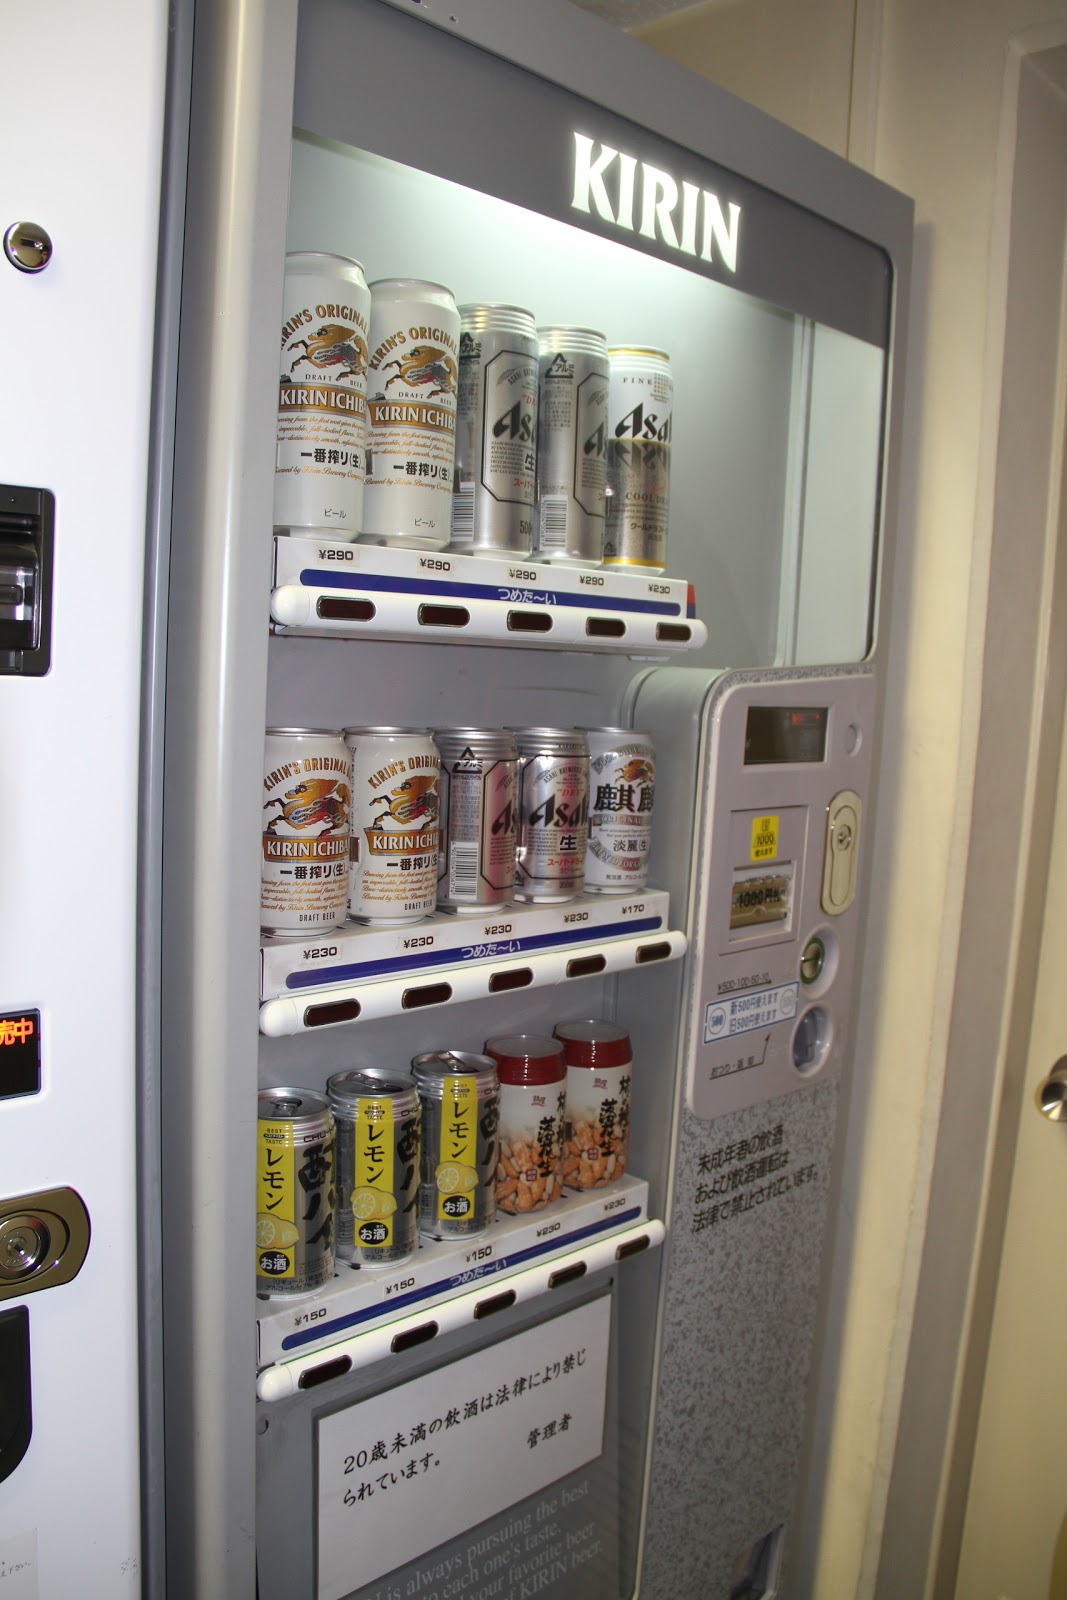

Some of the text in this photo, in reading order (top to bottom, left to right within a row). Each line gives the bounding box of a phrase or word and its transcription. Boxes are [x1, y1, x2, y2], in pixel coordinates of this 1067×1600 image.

[571, 131, 741, 273] KIRIN
[280, 304, 367, 350] IRIN'S ORIGINAL
[368, 326, 457, 370] KIRIN'S ORIGINAL
[462, 343, 481, 353] アルミ
[555, 364, 574, 373] アルミ
[305, 373, 362, 388] DRAFT BEER
[623, 377, 652, 385] FINE
[280, 389, 366, 415] KIRIN ICHIB
[398, 391, 424, 399] DRAFT
[375, 406, 456, 431] KIRIN ICHIB
[615, 402, 673, 443] Asa
[626, 492, 653, 502] COOL
[324, 508, 347, 519] ビール
[414, 518, 435, 528] ビール
[318, 549, 354, 561] ¥290
[420, 557, 451, 572] ¥290
[509, 568, 537, 581] ¥290
[580, 575, 605, 586] ¥290
[648, 583, 671, 594] ¥230
[464, 758, 483, 768] アルミ
[263, 757, 347, 791] KIRIN'S ORIGINAL
[368, 760, 406, 789] KIRIN'S
[543, 771, 558, 784] ASAHI
[267, 840, 311, 857] KIRIN
[373, 835, 414, 850] KIRIN
[560, 834, 577, 851] 生
[405, 902, 421, 910] DRAFT
[622, 904, 645, 914] ¥170
[299, 912, 336, 922] DRAFT BEER
[564, 912, 589, 922] ¥230
[484, 924, 512, 936] ¥230
[403, 936, 434, 949] ¥230
[303, 947, 337, 959] ¥230
[449, 1102, 470, 1159] レモン
[364, 1124, 385, 1183] レモン
[697, 1124, 784, 1176] 未成年者の飲酒
[263, 1148, 284, 1210] レモン
[695, 1149, 790, 1204] および飲酒運転は
[444, 1201, 468, 1213] お酒
[604, 1197, 626, 1211] ¥230
[360, 1228, 386, 1240] お酒
[536, 1223, 561, 1237] ¥230
[466, 1246, 492, 1263] ¥150
[261, 1257, 287, 1270] お酒
[386, 1278, 415, 1294] ¥150
[295, 1308, 327, 1326] ¥150
[343, 1348, 587, 1475] 20歳未満の飲酒は法律により禁じ
[526, 1412, 574, 1450] 管理者
[343, 1452, 441, 1507] られています。
[406, 1554, 464, 1597] always
[467, 1513, 532, 1570] pursuing
[536, 1501, 559, 1523] the
[561, 1480, 592, 1504] best
[443, 1568, 480, 1598] each
[483, 1542, 522, 1576] one's
[524, 1522, 562, 1551] taste.
[507, 1543, 562, 1586] favorite
[565, 1522, 596, 1547] beer
[519, 1560, 568, 1600] KIRIN
